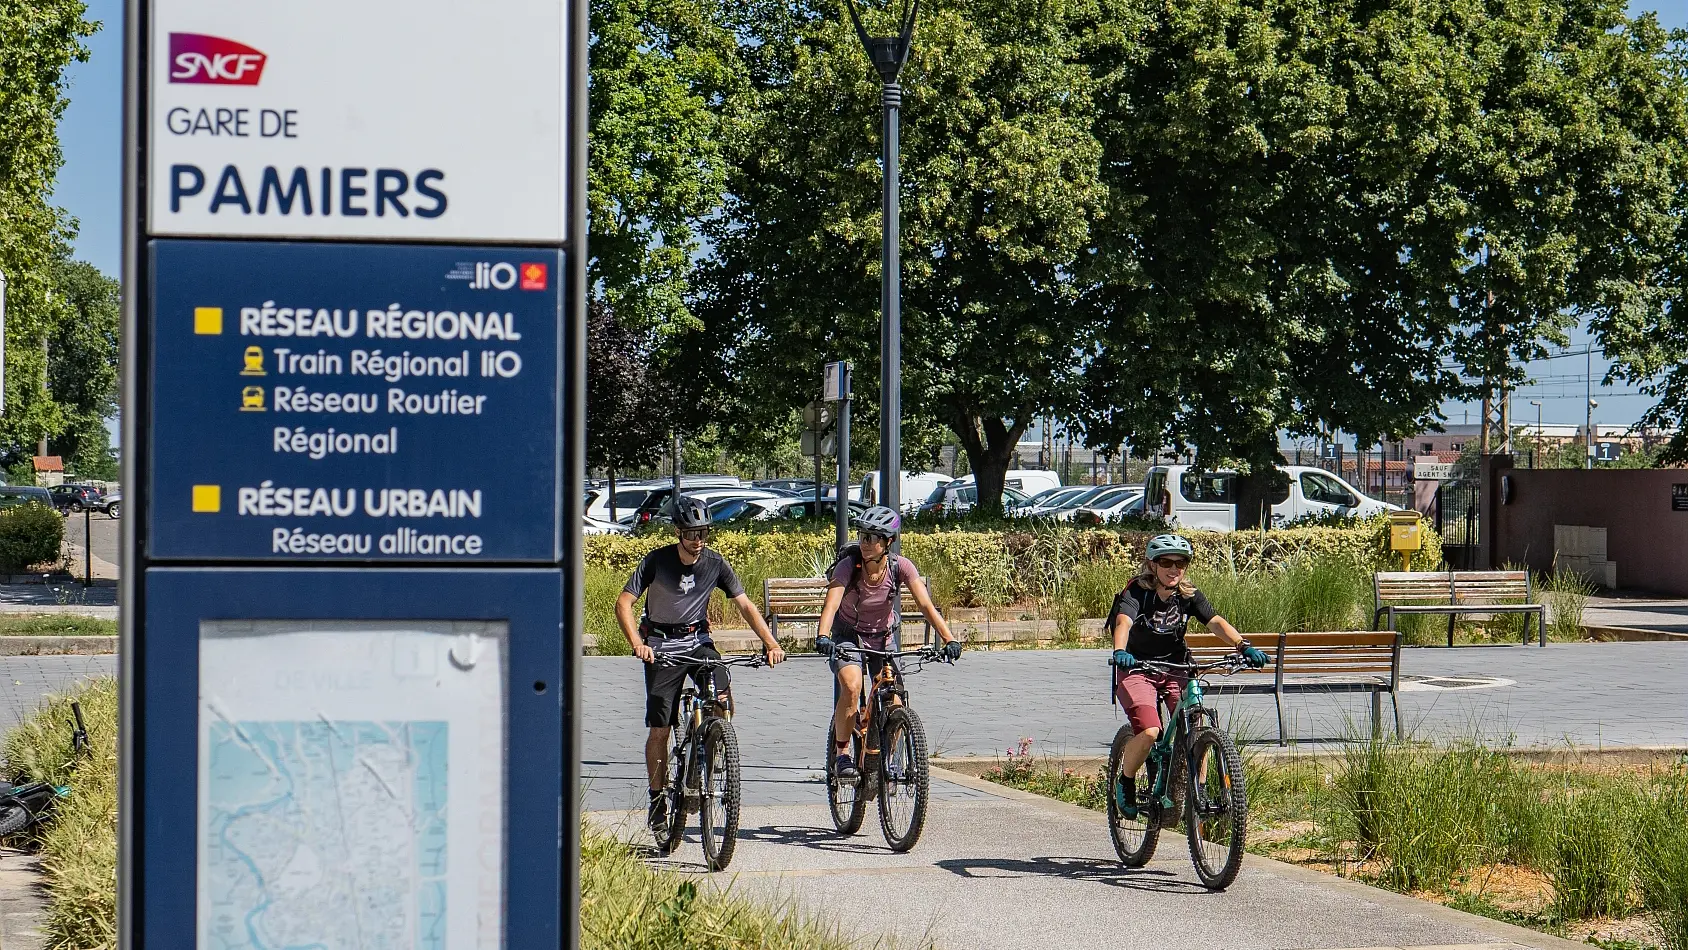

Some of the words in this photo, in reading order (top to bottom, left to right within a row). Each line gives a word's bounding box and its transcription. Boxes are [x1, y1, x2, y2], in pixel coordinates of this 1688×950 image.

[171, 52, 262, 81] SNCF
[167, 107, 250, 138] GARE
[260, 108, 298, 139] DE
[170, 164, 448, 219] PAMIERS
[240, 300, 358, 338] RÉSEAU
[366, 302, 522, 341] RÉGIONAL
[273, 348, 343, 375] Train
[351, 349, 469, 383] Régional
[274, 385, 378, 414] Réseau
[387, 388, 487, 415] Routier
[273, 426, 398, 460] Régional
[238, 479, 356, 517] RÉSEAU
[364, 487, 482, 518] URBAIN
[272, 527, 372, 554] Réseau
[378, 527, 483, 555] alliance
